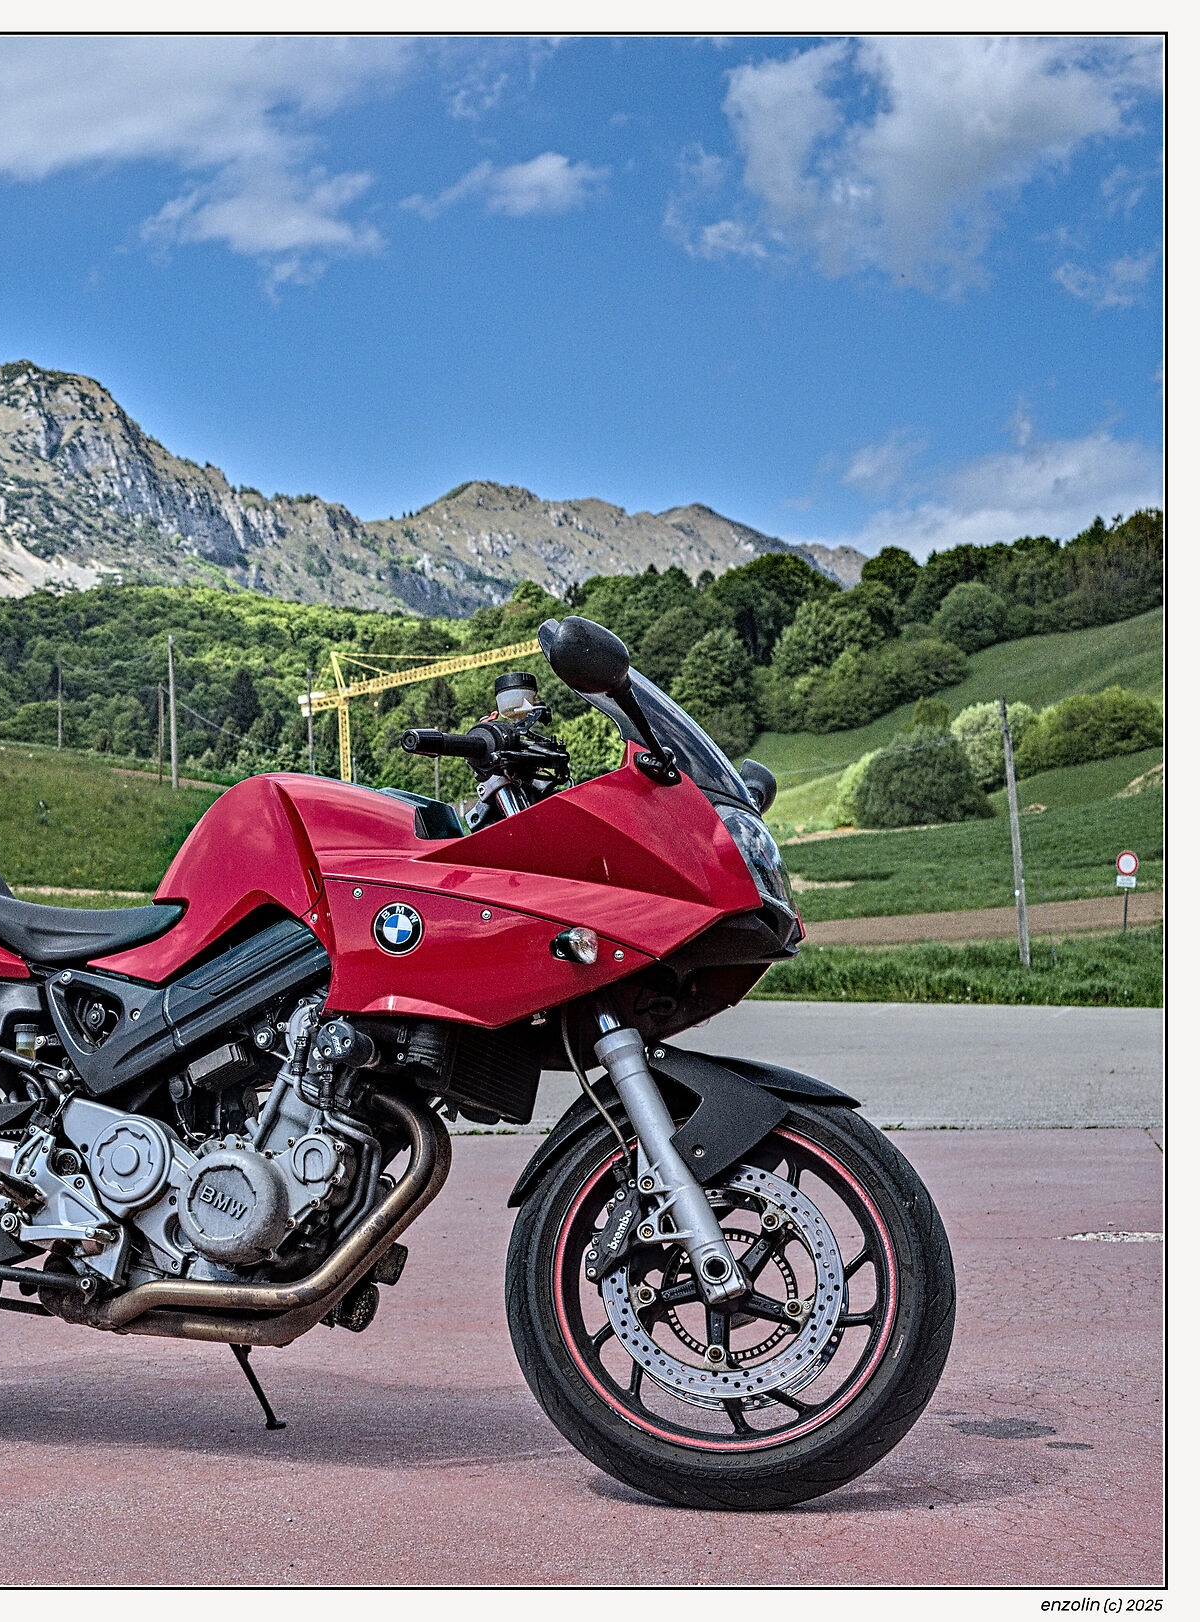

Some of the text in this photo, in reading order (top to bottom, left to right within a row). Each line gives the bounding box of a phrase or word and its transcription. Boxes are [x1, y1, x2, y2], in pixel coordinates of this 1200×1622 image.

[381, 905, 419, 924] BMW
[199, 1184, 247, 1220] BMW
[606, 1210, 633, 1251] brembo
